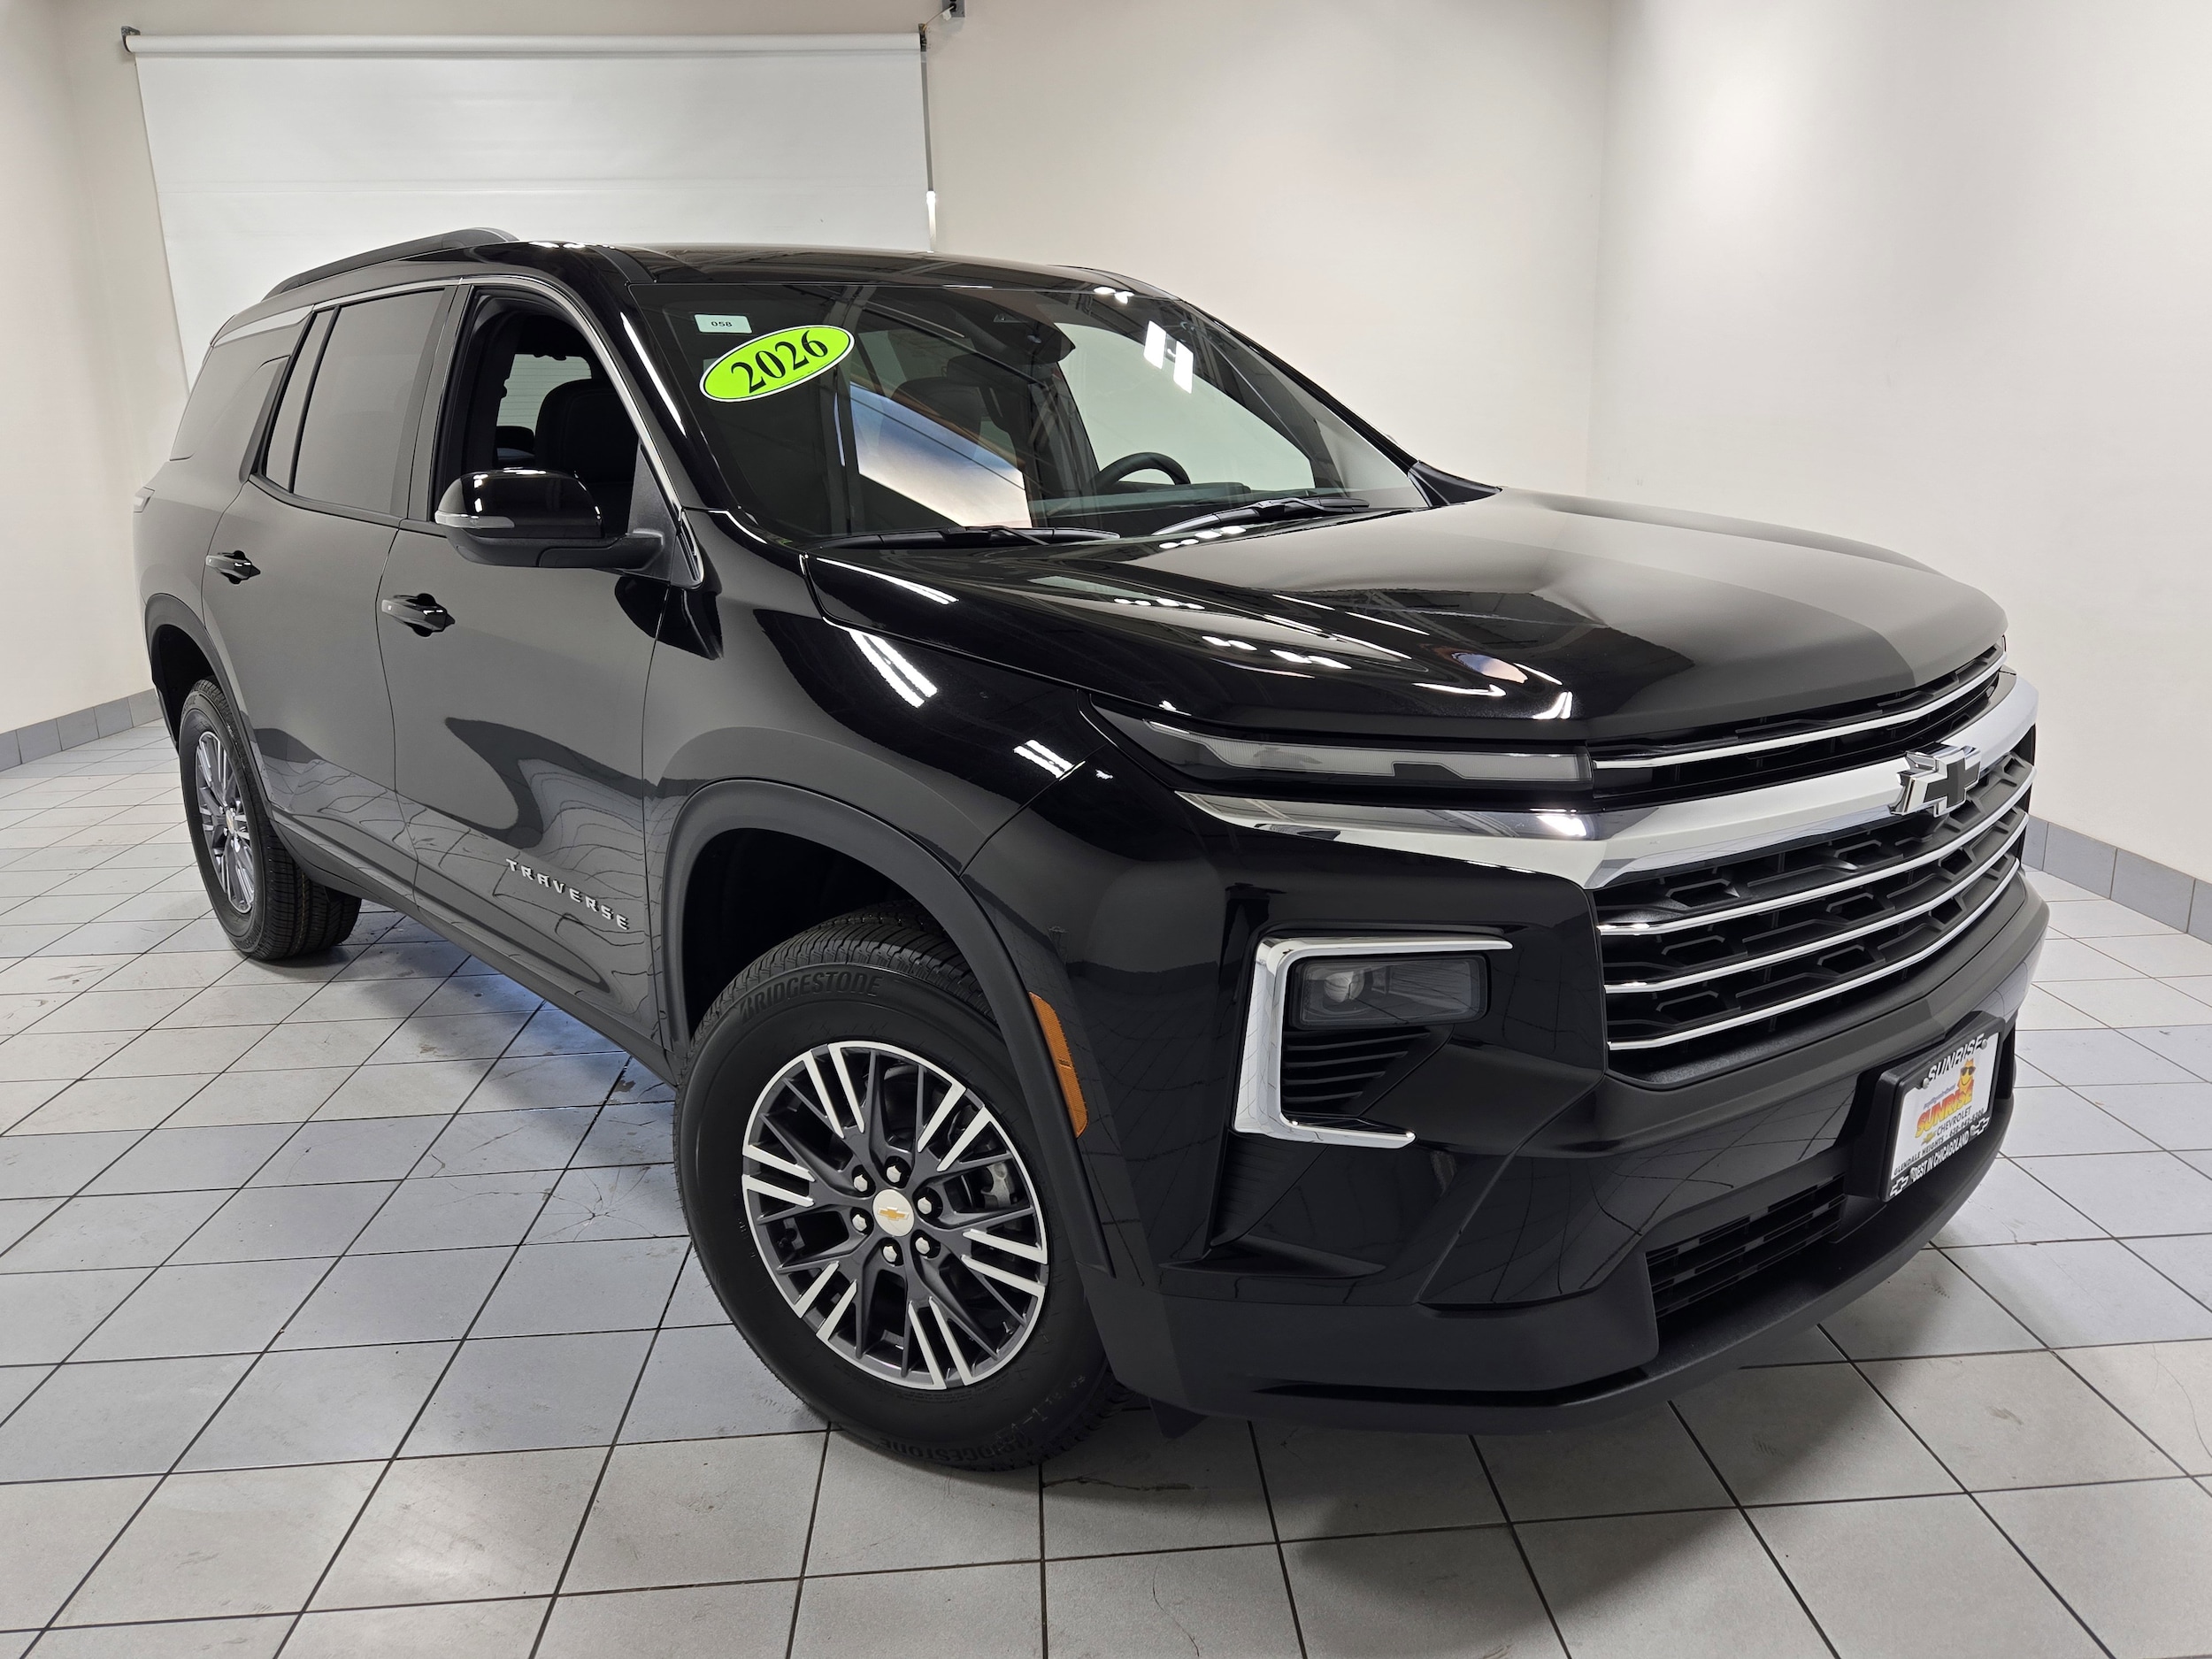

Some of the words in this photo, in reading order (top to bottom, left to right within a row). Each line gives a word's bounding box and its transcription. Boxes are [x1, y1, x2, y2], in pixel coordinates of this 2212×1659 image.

[731, 329, 828, 394] 2026
[505, 858, 629, 930] TRAVERSE
[740, 971, 883, 1024] BRIDGESTONE
[1928, 1033, 1985, 1082] SUNRISE
[1915, 1088, 1973, 1139] SUNRISE
[1936, 1106, 1972, 1136] CHEVROLET
[1893, 1150, 1921, 1176] GLENDALE
[1921, 1134, 1945, 1156] HEIGHTS
[1926, 1155, 1934, 1173] IN
[1933, 1130, 1970, 1168] CHICAGOLAND
